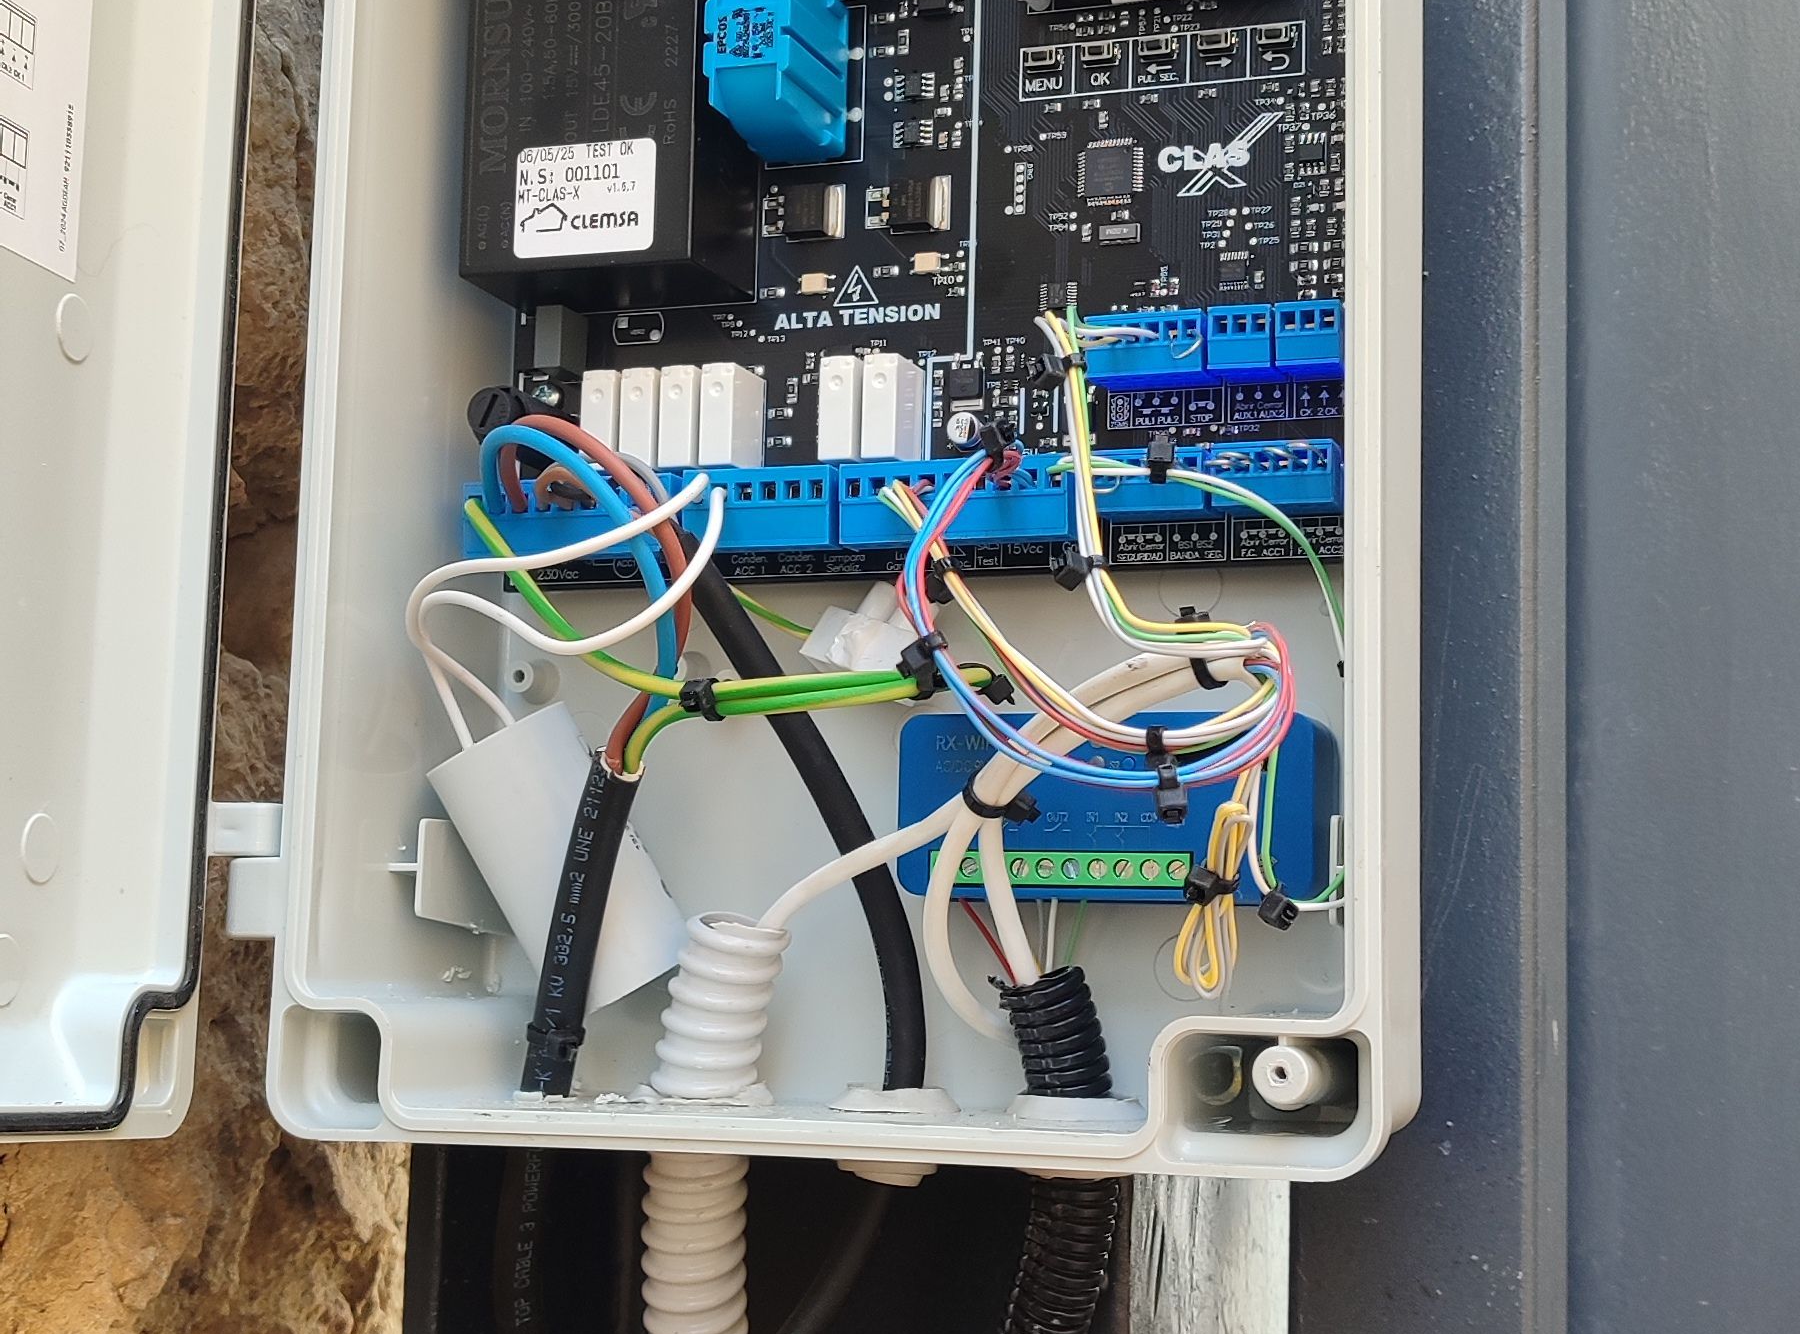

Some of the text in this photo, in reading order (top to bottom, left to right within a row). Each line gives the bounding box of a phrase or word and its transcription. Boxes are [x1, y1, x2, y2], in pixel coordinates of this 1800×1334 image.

[1025, 76, 1062, 93] MENU
[1091, 72, 1110, 86] OK
[586, 142, 613, 159] TEST
[620, 141, 634, 156] OK
[1157, 141, 1251, 173] CLAS
[565, 163, 621, 182] 001101
[570, 211, 639, 230] CLEMSA
[774, 303, 941, 331] ALTA TENSION
[1190, 414, 1214, 423] STOP
[734, 566, 755, 575] ACC
[780, 565, 801, 574] ACC
[978, 557, 999, 566] Test
[537, 569, 579, 581] 230Vac
[573, 827, 595, 862] UNE
